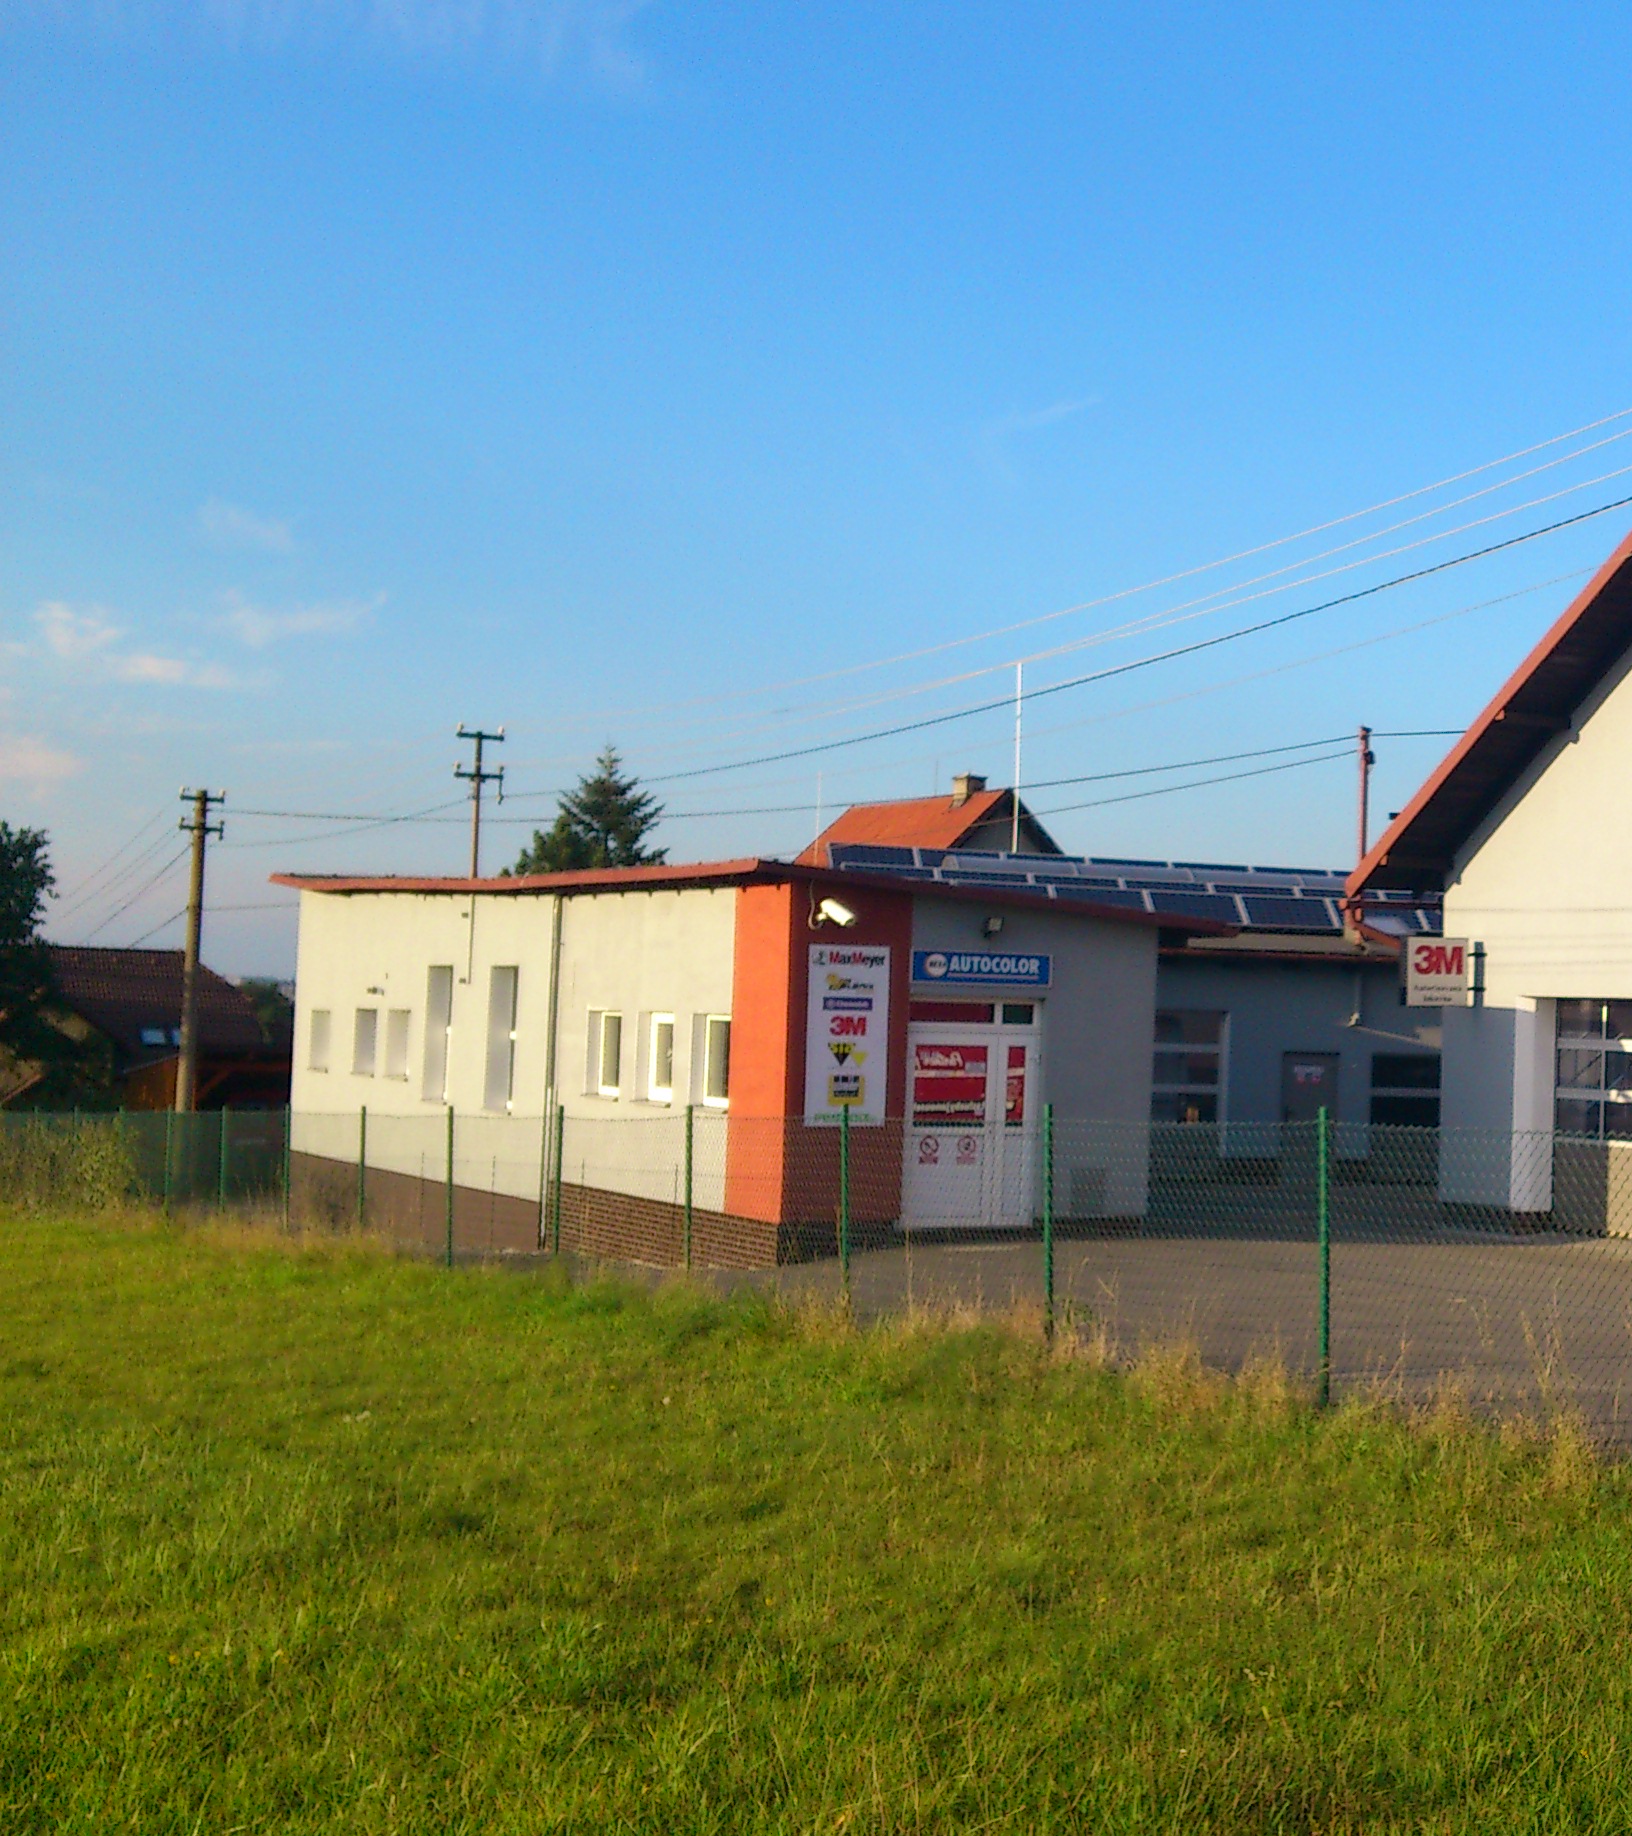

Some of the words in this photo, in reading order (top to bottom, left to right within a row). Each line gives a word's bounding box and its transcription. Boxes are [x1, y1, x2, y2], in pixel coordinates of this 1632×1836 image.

[949, 955, 1040, 974] AUTOCOLOR
[1414, 945, 1464, 975] 3M
[829, 1015, 867, 1036] 3M
